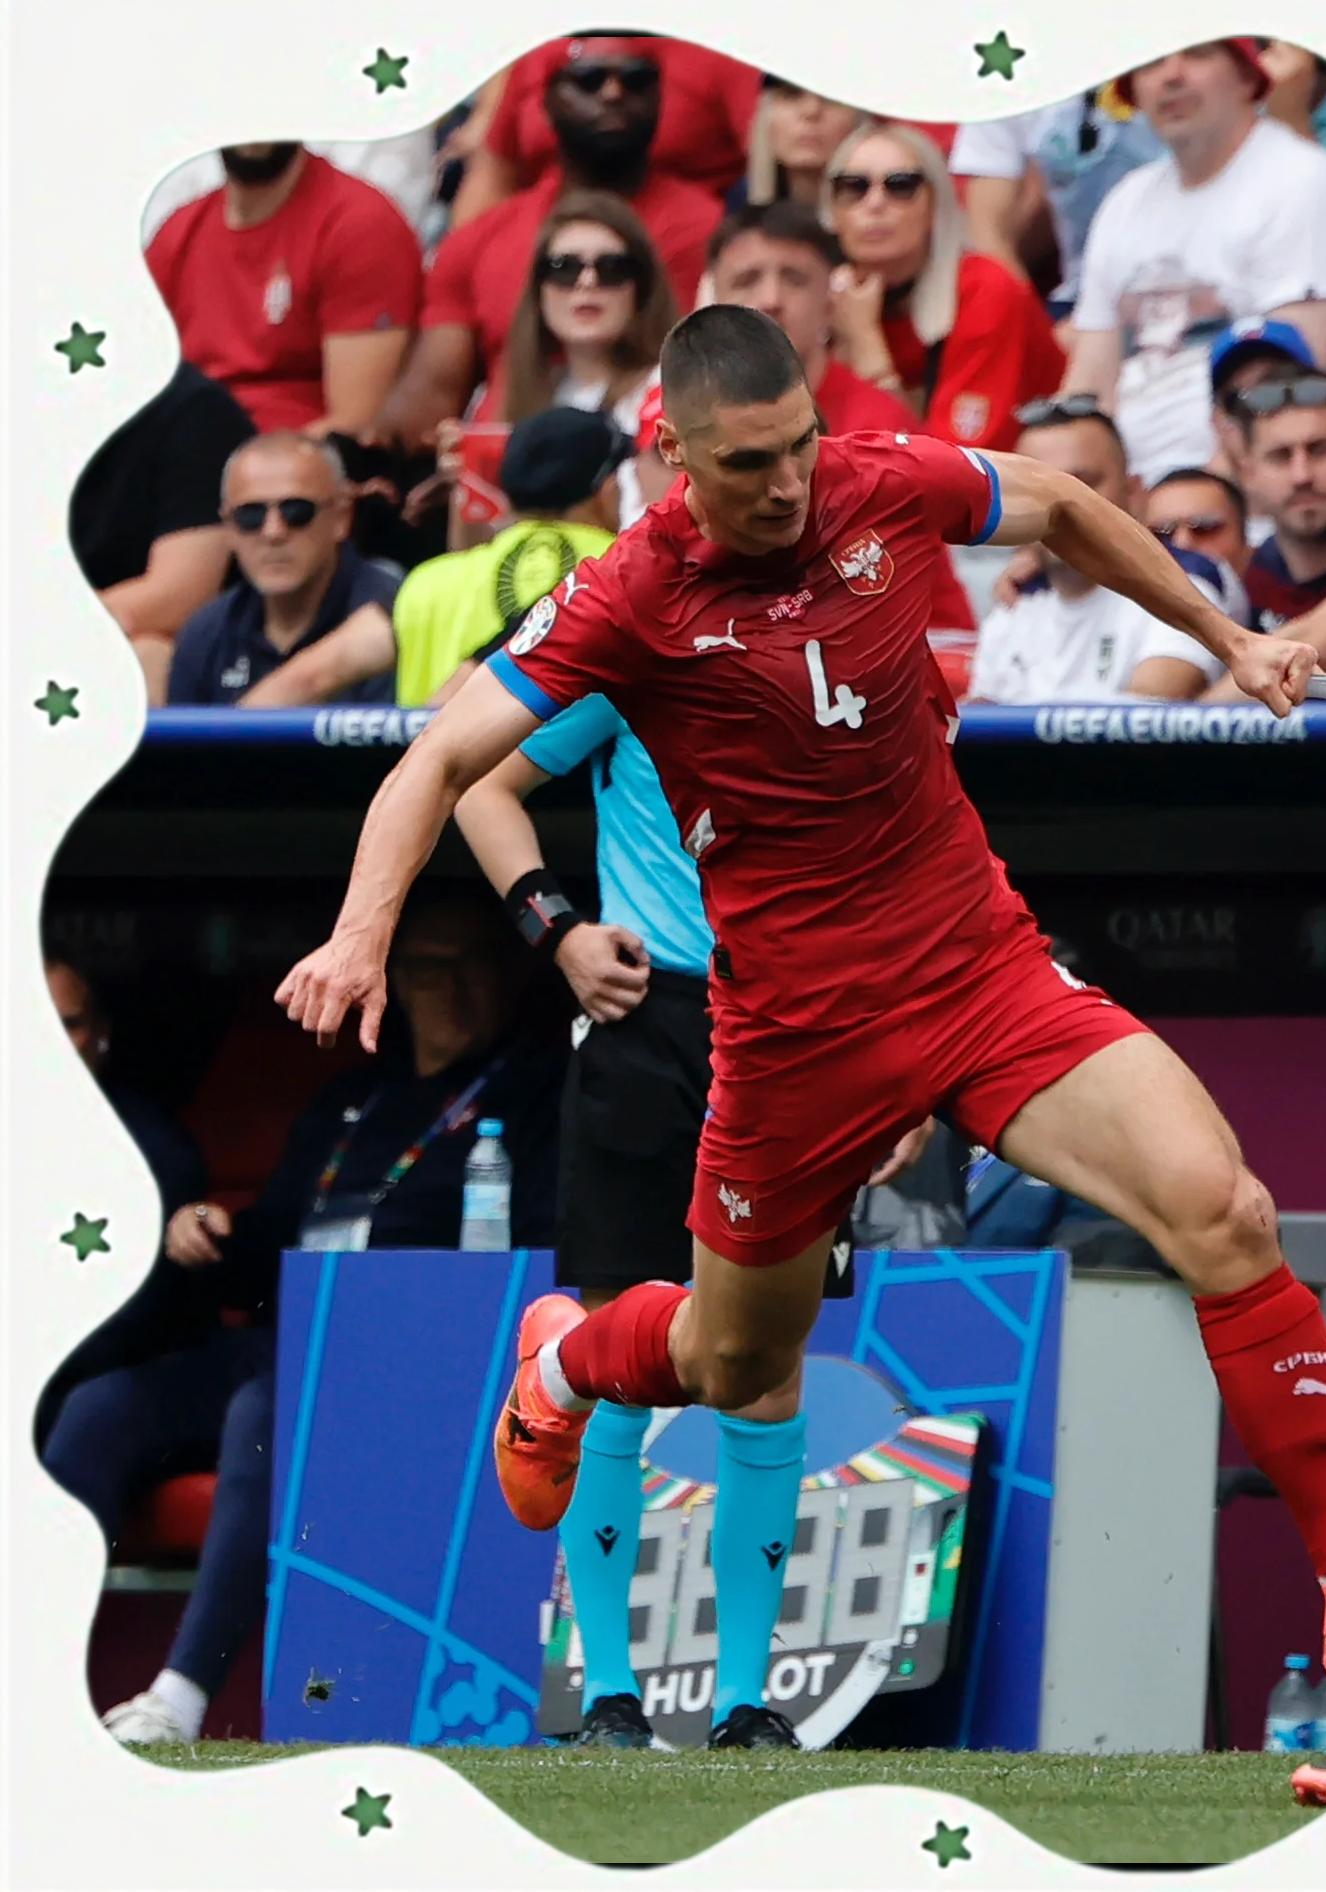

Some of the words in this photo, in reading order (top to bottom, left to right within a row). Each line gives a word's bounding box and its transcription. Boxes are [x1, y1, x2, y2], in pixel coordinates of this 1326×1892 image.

[805, 639, 867, 729] 4
[1106, 908, 1237, 950] QATAR
[642, 1653, 836, 1717] HUOT
